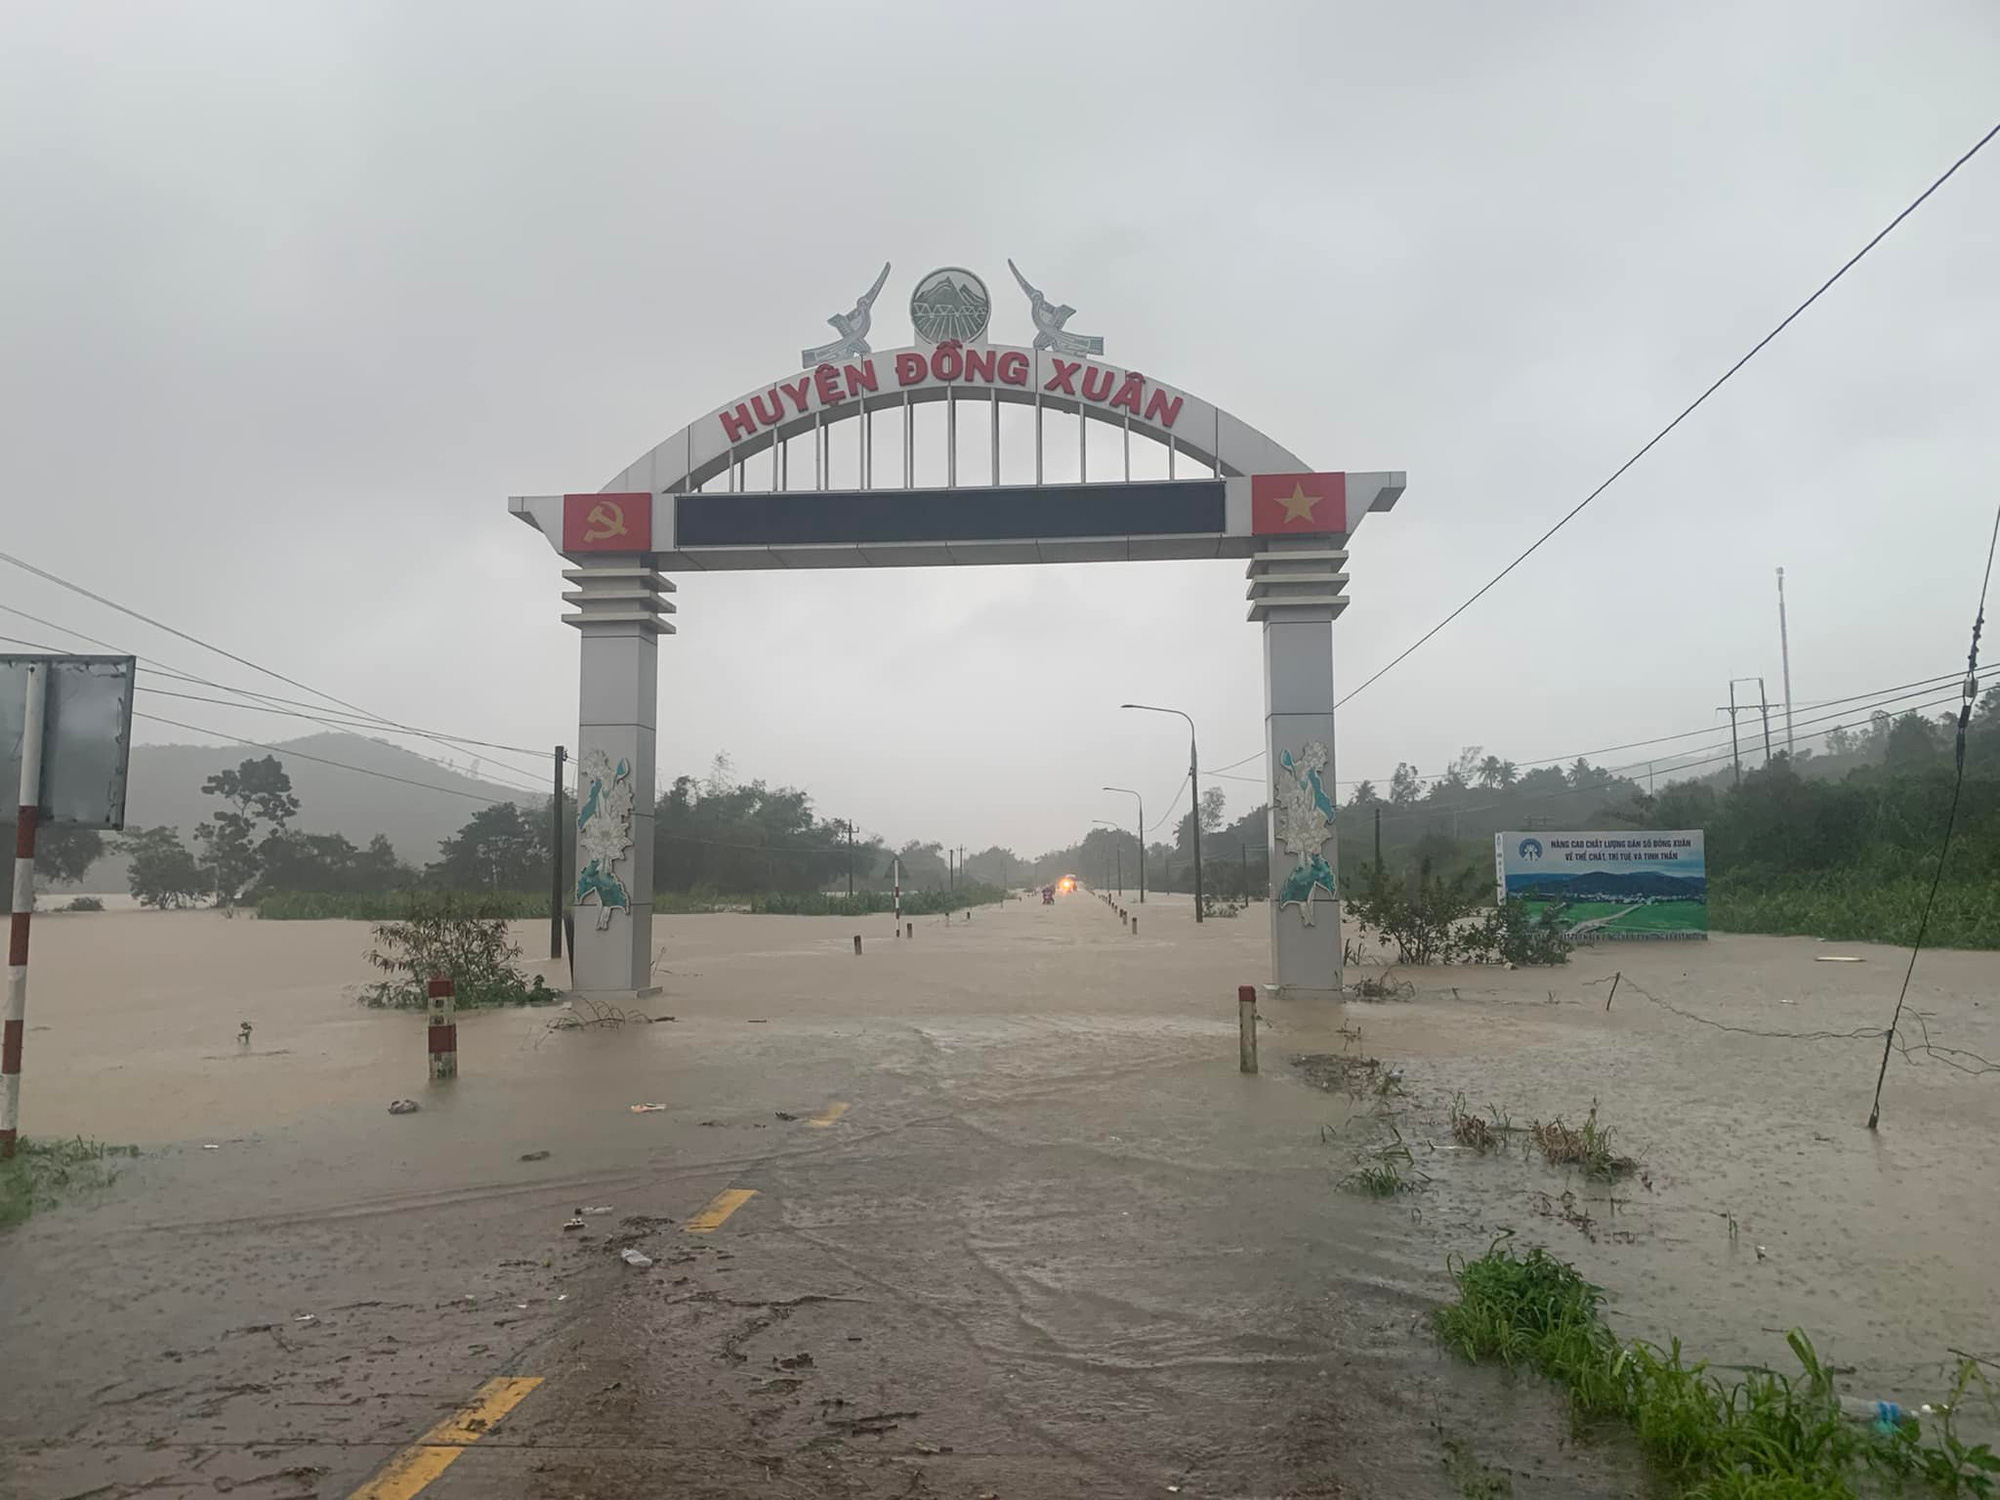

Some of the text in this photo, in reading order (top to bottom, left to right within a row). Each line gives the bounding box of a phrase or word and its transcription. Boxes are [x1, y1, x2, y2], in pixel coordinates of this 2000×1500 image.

[719, 338, 1184, 443] HUYỆN ĐỒNG XUÂN
[1571, 840, 1585, 848] CAO
